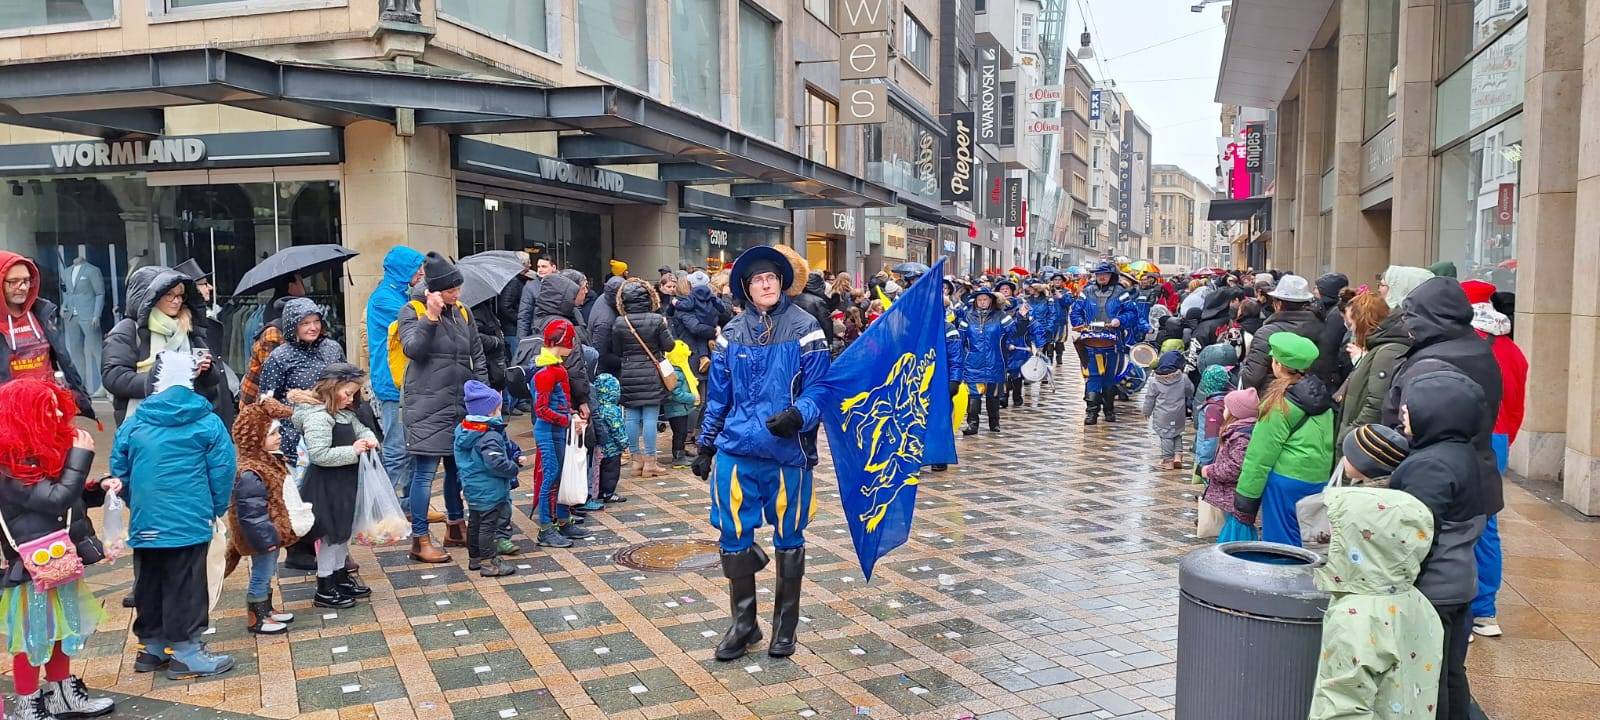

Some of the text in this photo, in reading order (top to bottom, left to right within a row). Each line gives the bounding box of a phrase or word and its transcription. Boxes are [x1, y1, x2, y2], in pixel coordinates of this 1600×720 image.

[982, 64, 995, 139] SWAROVSKI
[1091, 94, 1100, 116] KKH
[51, 138, 206, 168] WORMLAND
[950, 119, 973, 195] Pieper
[1247, 132, 1263, 168] snipes
[538, 157, 624, 193] WORMLAND
[1010, 182, 1019, 222] comma,
